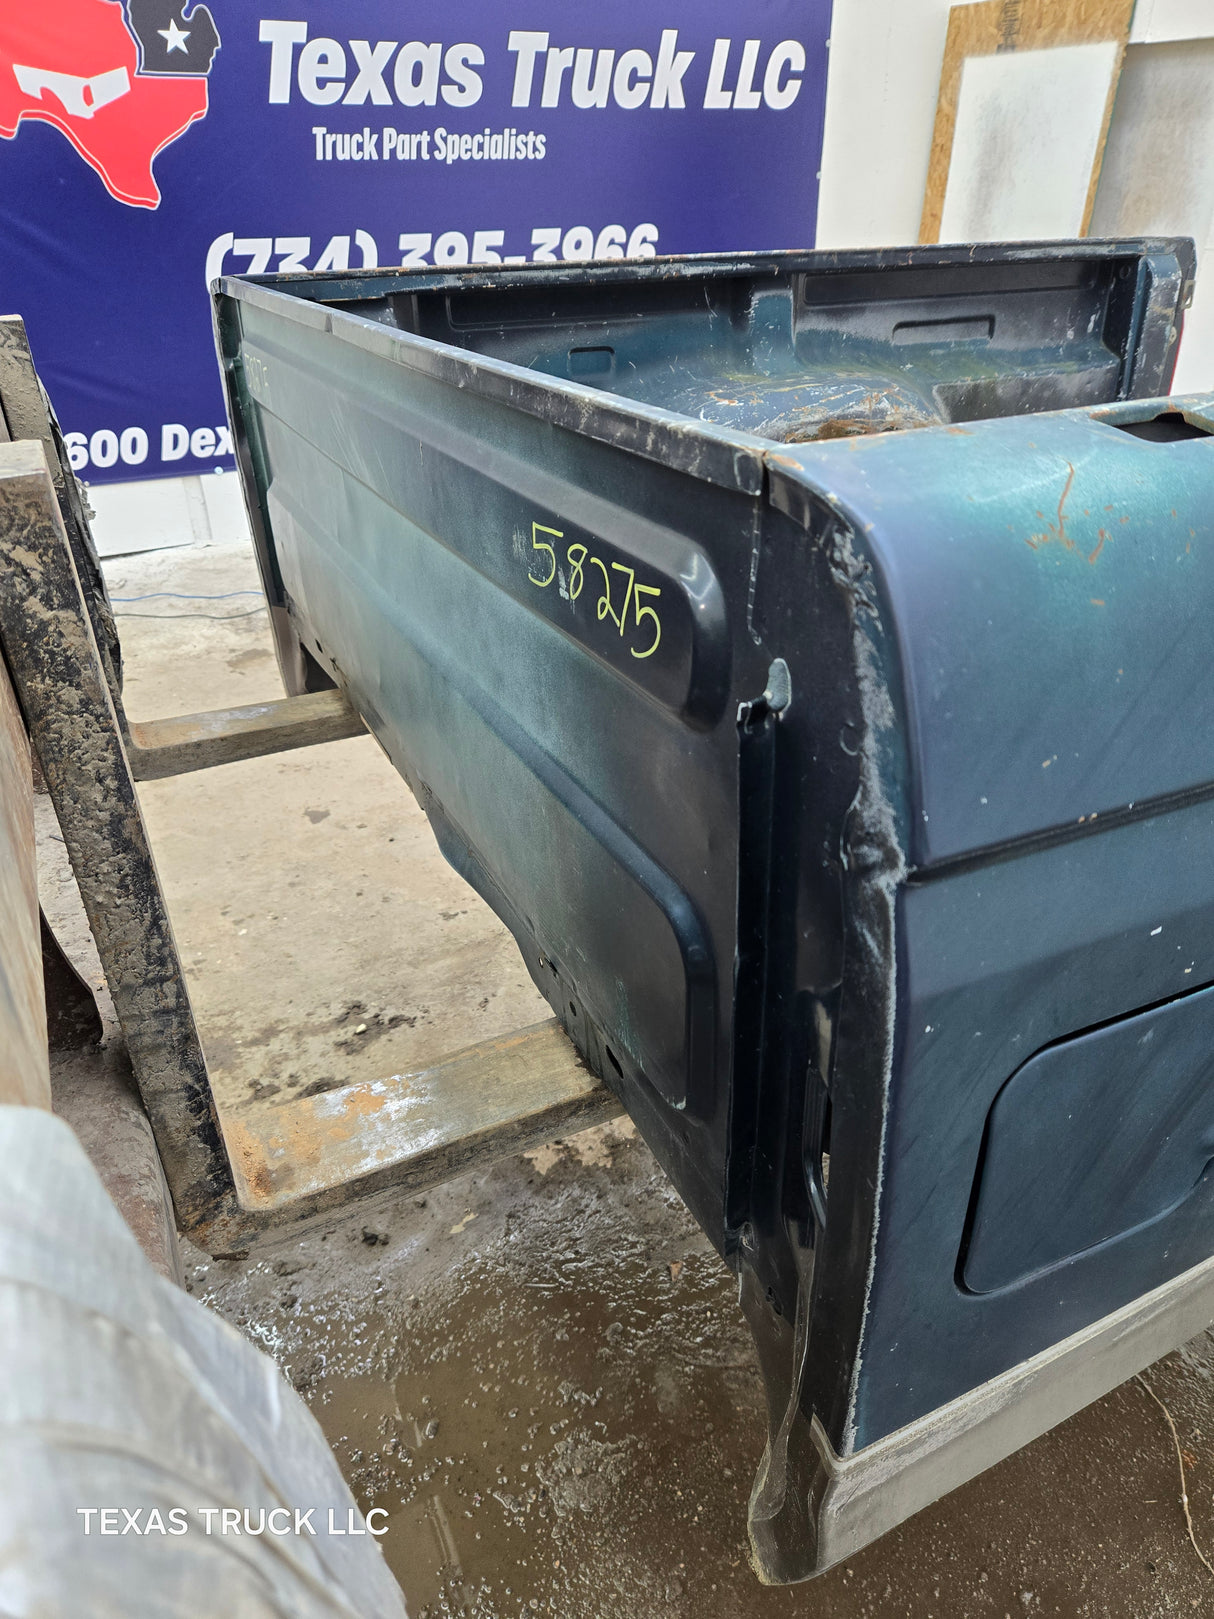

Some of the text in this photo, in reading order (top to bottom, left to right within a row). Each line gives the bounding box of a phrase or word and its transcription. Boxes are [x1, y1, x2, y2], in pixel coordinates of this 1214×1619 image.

[258, 19, 806, 110] Texas Truck LLC
[311, 126, 547, 164] Truck Part Specialists
[528, 521, 662, 659] 58275
